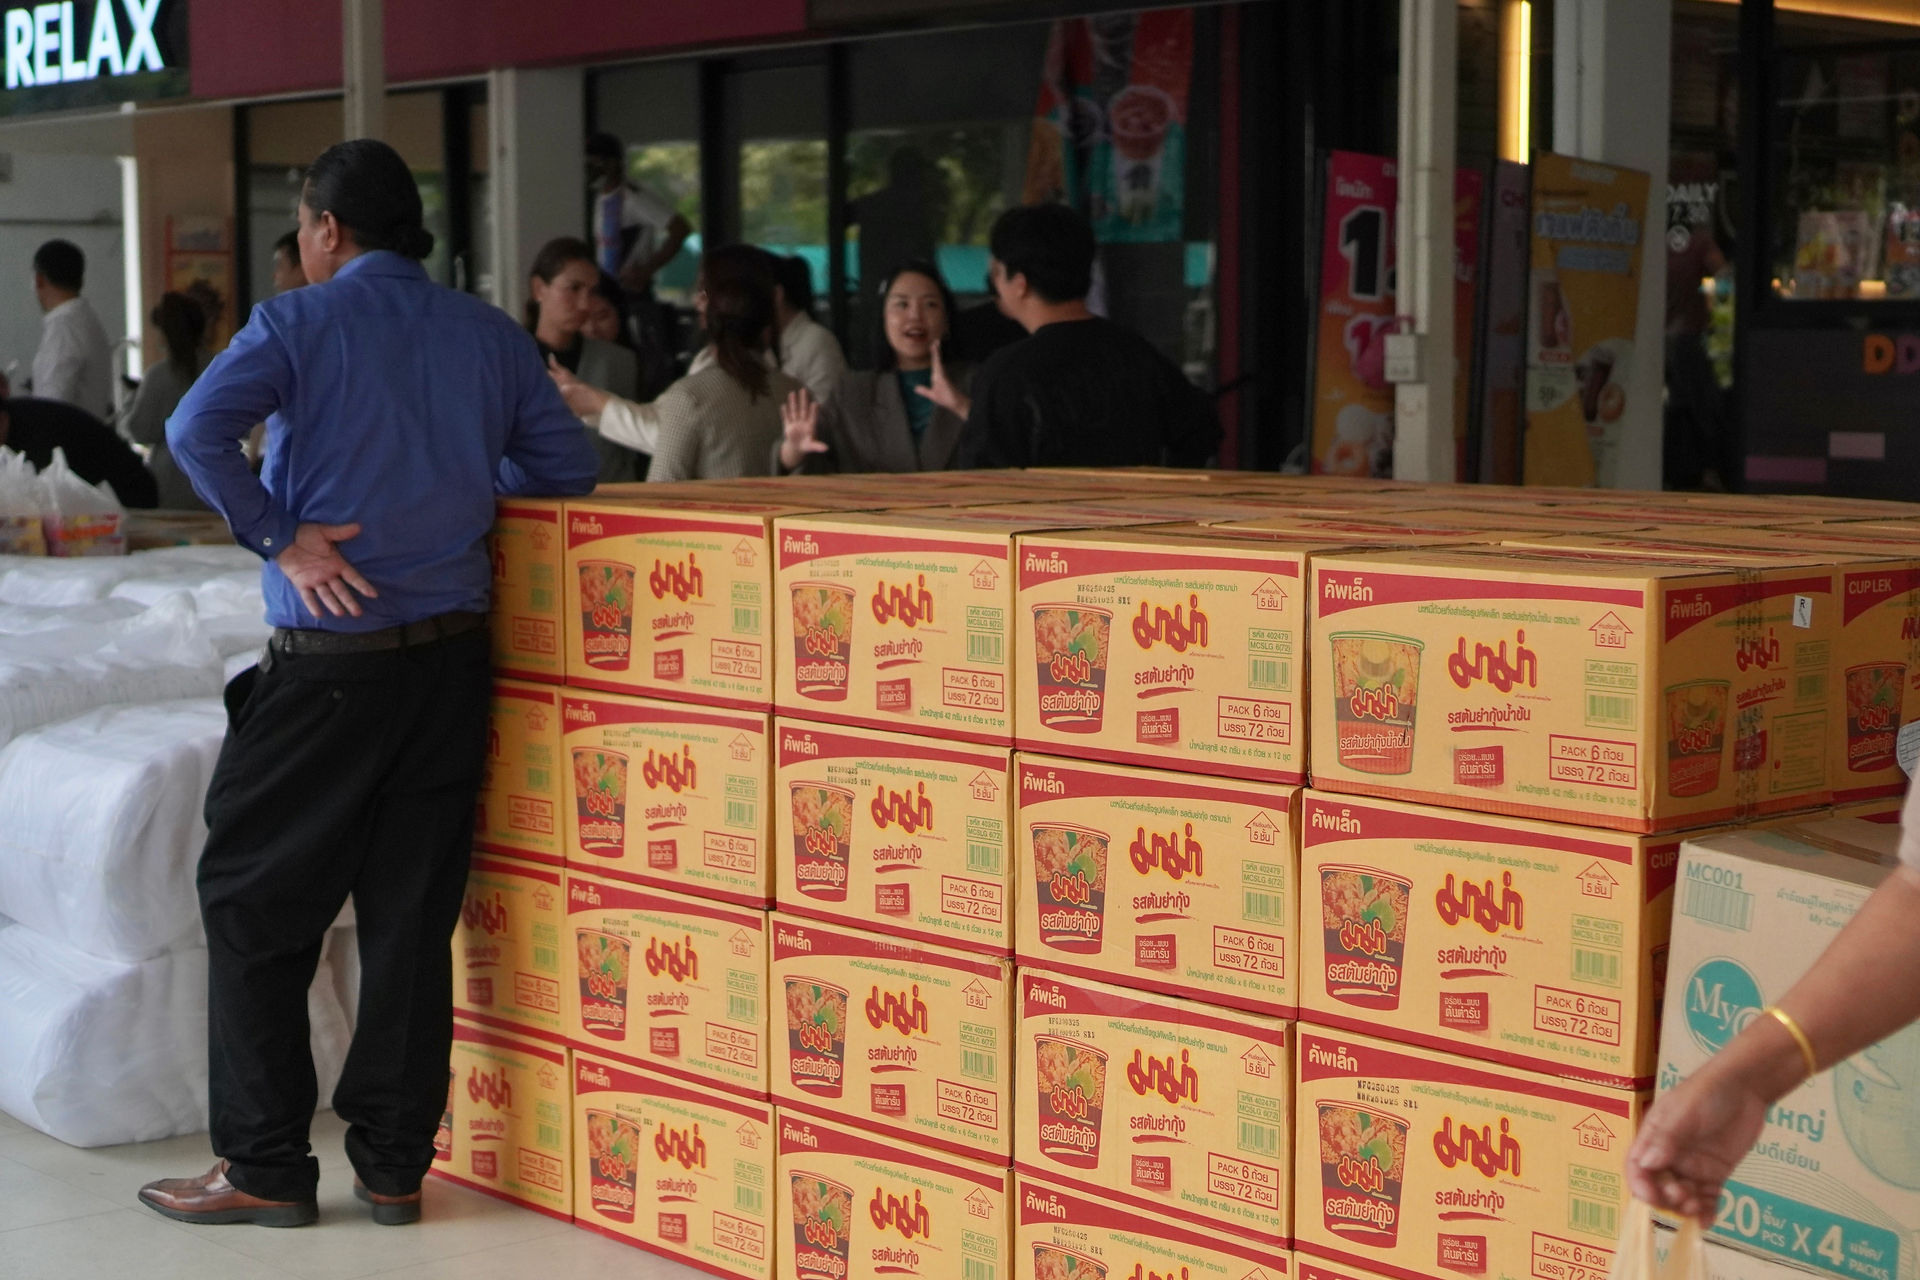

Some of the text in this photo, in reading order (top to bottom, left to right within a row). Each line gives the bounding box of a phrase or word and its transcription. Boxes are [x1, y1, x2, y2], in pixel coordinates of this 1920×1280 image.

[5, 0, 165, 90] RELAX
[572, 515, 602, 535] คัพเล็ก
[784, 534, 818, 555] คัพเล็ก
[1025, 550, 1067, 573] คัพเล็ก
[1324, 576, 1373, 602] คัพเล็ก
[1849, 578, 1893, 594] CUP LEK
[871, 573, 933, 628] มาม่า
[1260, 594, 1278, 608] 5 ชั้น
[1670, 594, 1712, 619] คัพเล็ก
[1800, 598, 1806, 609] R
[1131, 593, 1207, 653] มาม่า
[873, 637, 923, 658] รสต้มยำกุ้ง
[1599, 630, 1621, 645] 5 ชั้น
[797, 661, 846, 685] รสต้มยำกุ้ง
[1050, 650, 1090, 684] มาม่า
[1447, 628, 1537, 693] มาม่า
[1134, 663, 1194, 686] รสต้มยำกุ้ง
[565, 702, 596, 722] คัพเล็ก
[1040, 690, 1100, 716] รสต้มยำกุ้ง
[1227, 703, 1281, 718] PACK 6 ถ้วย
[1350, 683, 1397, 721] มาม่า
[1447, 703, 1531, 725] รสต้มยำกุ้งน้ำข้น
[1223, 722, 1285, 738] บรรจุ 72 ถ้วย
[1339, 724, 1410, 751] รสต้มยำกุ้งน้ำข้น
[783, 733, 818, 755] คัพเล็ก
[1560, 743, 1624, 762] PACK 6 ถ้วย
[1459, 763, 1495, 774] ต้นตำรับ
[1556, 764, 1630, 784] บรรจุ 72 ถ้วย
[1023, 770, 1065, 794] คัพเล็ก
[870, 780, 933, 834] มาม่า
[1312, 807, 1360, 834] คัพเล็ก
[1253, 828, 1271, 842] 5 ชั้น
[873, 843, 922, 864] รสต้มยำกุ้ง
[1128, 822, 1202, 880] มาม่า
[797, 860, 845, 886] รสต้มยำกุ้ง
[1686, 860, 1744, 890] MC001
[570, 884, 599, 906] คัพเล็ก
[1049, 871, 1089, 905] มาม่า
[1586, 879, 1607, 896] 5 ชั้น
[1132, 891, 1190, 913] รสต้มยำกุ้ง
[1434, 870, 1523, 933] มาม่า
[1041, 909, 1099, 937] รสต้มยำกุ้ง
[777, 928, 811, 952] คัพเล็ก
[1222, 934, 1274, 952] PACK 6 ถ้วย
[1339, 918, 1386, 955] มาม่า
[1219, 951, 1279, 971] บรรจุ 72 ถ้วย
[1437, 944, 1507, 970] รสต้มยำกุ้ง
[1328, 960, 1397, 992] รสต้มยำกุ้ง
[864, 983, 927, 1036] มาม่า
[1027, 984, 1066, 1010] คัพเล็ก
[1545, 994, 1608, 1016] PACK 6 ถ้วย
[1445, 1005, 1481, 1019] ต้นตำรับ
[1541, 1014, 1613, 1038] บรรจุ 72 ถ้วย
[867, 1044, 917, 1066] รสต้มยำกุ้ง
[1309, 1042, 1357, 1072] คัพเล็ก
[580, 1065, 609, 1088] คัพเล็ก
[792, 1055, 840, 1082] รสต้มยำกุ้ง
[1126, 1047, 1198, 1104] มาม่า
[1049, 1085, 1087, 1118] มาม่า
[783, 1122, 817, 1148] คัพเล็ก
[1040, 1122, 1096, 1152] รสต้มยำกุ้ง
[1128, 1112, 1185, 1137] รสต้มยำกุ้ง
[1432, 1115, 1521, 1178] มาม่า
[1583, 1131, 1604, 1148] 5 ชั้น
[1336, 1155, 1383, 1192] มาม่า
[868, 1185, 929, 1239] มาม่า
[1026, 1190, 1065, 1219] คัพเล็ก
[1326, 1196, 1395, 1229] รสต้มยำกุ้ง
[1434, 1187, 1505, 1214] รสต้มยำกุ้ง
[1762, 1230, 1786, 1248] PCS
[1817, 1224, 1845, 1266] 4
[797, 1251, 844, 1279] รสต้มยำกุ้ง
[871, 1246, 919, 1269] รสต้มยำกุ้ง
[1443, 1246, 1478, 1262] ต้นตำรับ
[1849, 1258, 1889, 1280] PACKS
